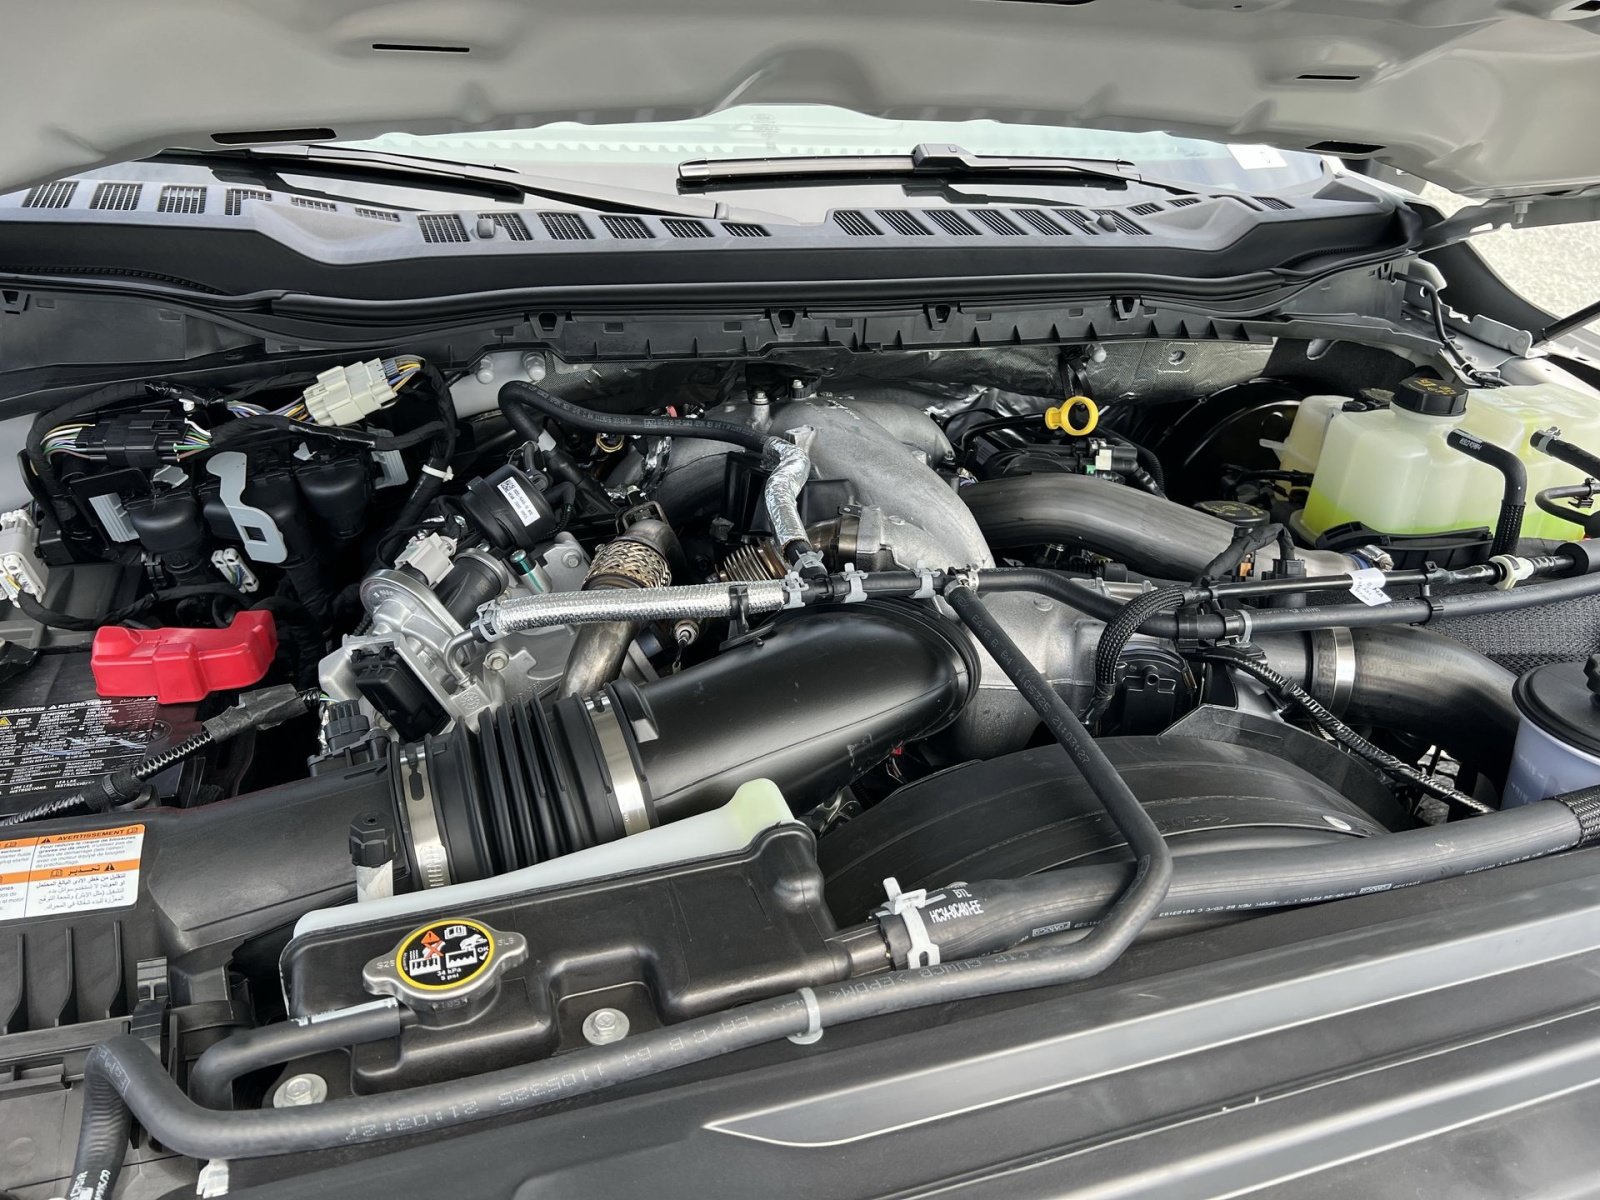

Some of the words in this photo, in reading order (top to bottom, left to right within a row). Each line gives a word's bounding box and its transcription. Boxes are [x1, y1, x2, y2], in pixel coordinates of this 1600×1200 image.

[57, 830, 125, 841] AVERTISSEMENT
[954, 889, 972, 898] BTL
[447, 967, 462, 975] kPa
[447, 973, 460, 981] psi
[497, 1063, 605, 1107] 1105325
